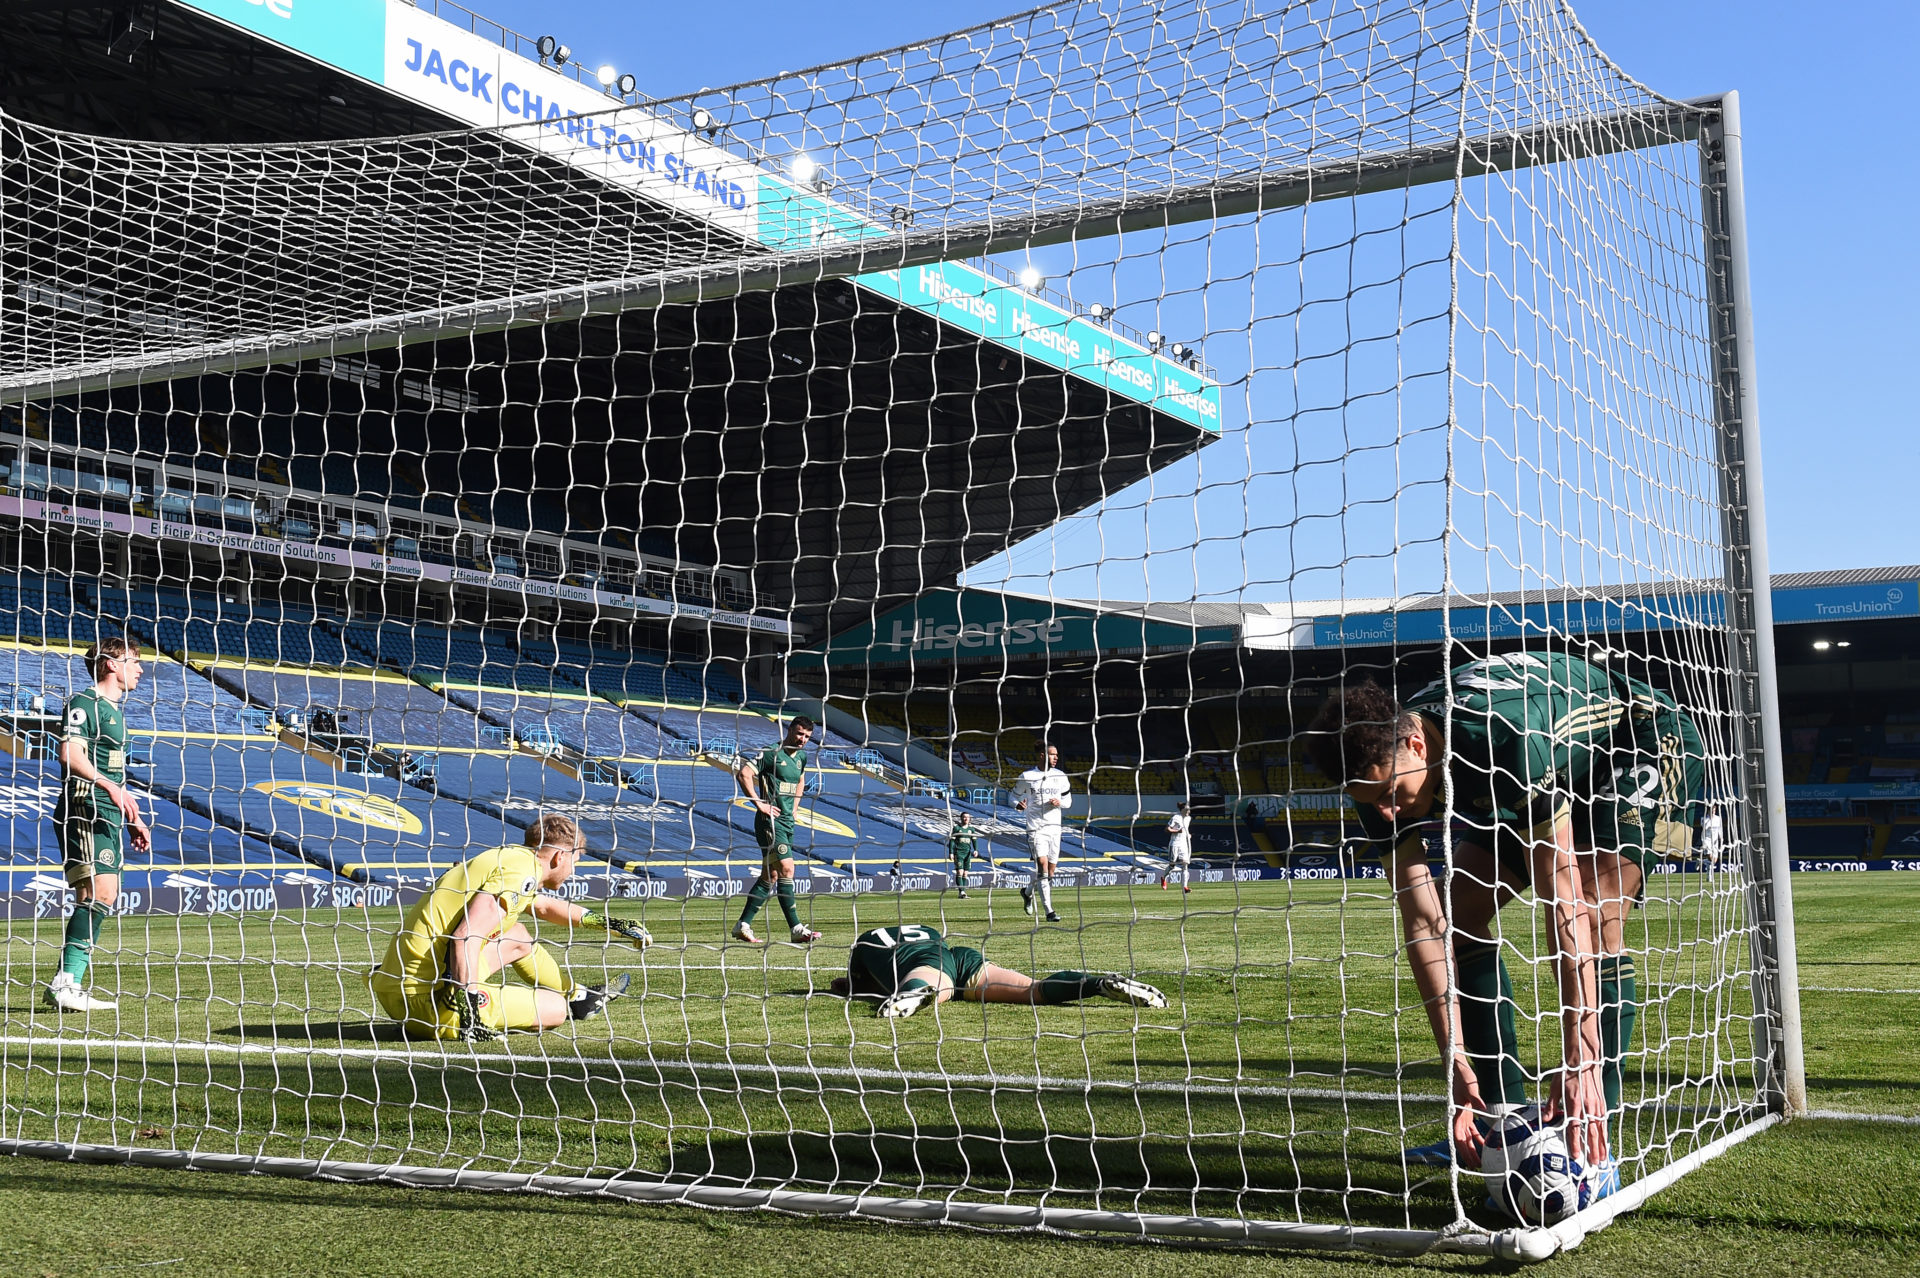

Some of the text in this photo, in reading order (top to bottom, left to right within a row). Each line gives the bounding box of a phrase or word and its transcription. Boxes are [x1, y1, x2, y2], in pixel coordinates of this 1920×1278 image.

[405, 38, 747, 212] JACK CHARLTON STAND
[918, 264, 998, 325] Hisense
[1012, 307, 1080, 360] Hisense
[1093, 343, 1153, 392] Hisense
[1164, 376, 1217, 420] Hisense
[64, 514, 114, 528] costructon
[151, 522, 203, 541] Eficient
[285, 544, 336, 562] Solutons
[1815, 600, 1892, 615] TransUnion
[748, 617, 777, 629] olutions
[1437, 622, 1503, 634] TansUnion
[1556, 614, 1624, 628] TransUnion
[891, 618, 1064, 653] Hisense
[1325, 629, 1388, 641] TransUnion
[1294, 868, 1338, 879] SBOTOP
[1815, 862, 1867, 872] SOTOP
[206, 888, 275, 911] SBOTOP
[331, 886, 393, 907] SBOTOP
[871, 924, 930, 948] 15
